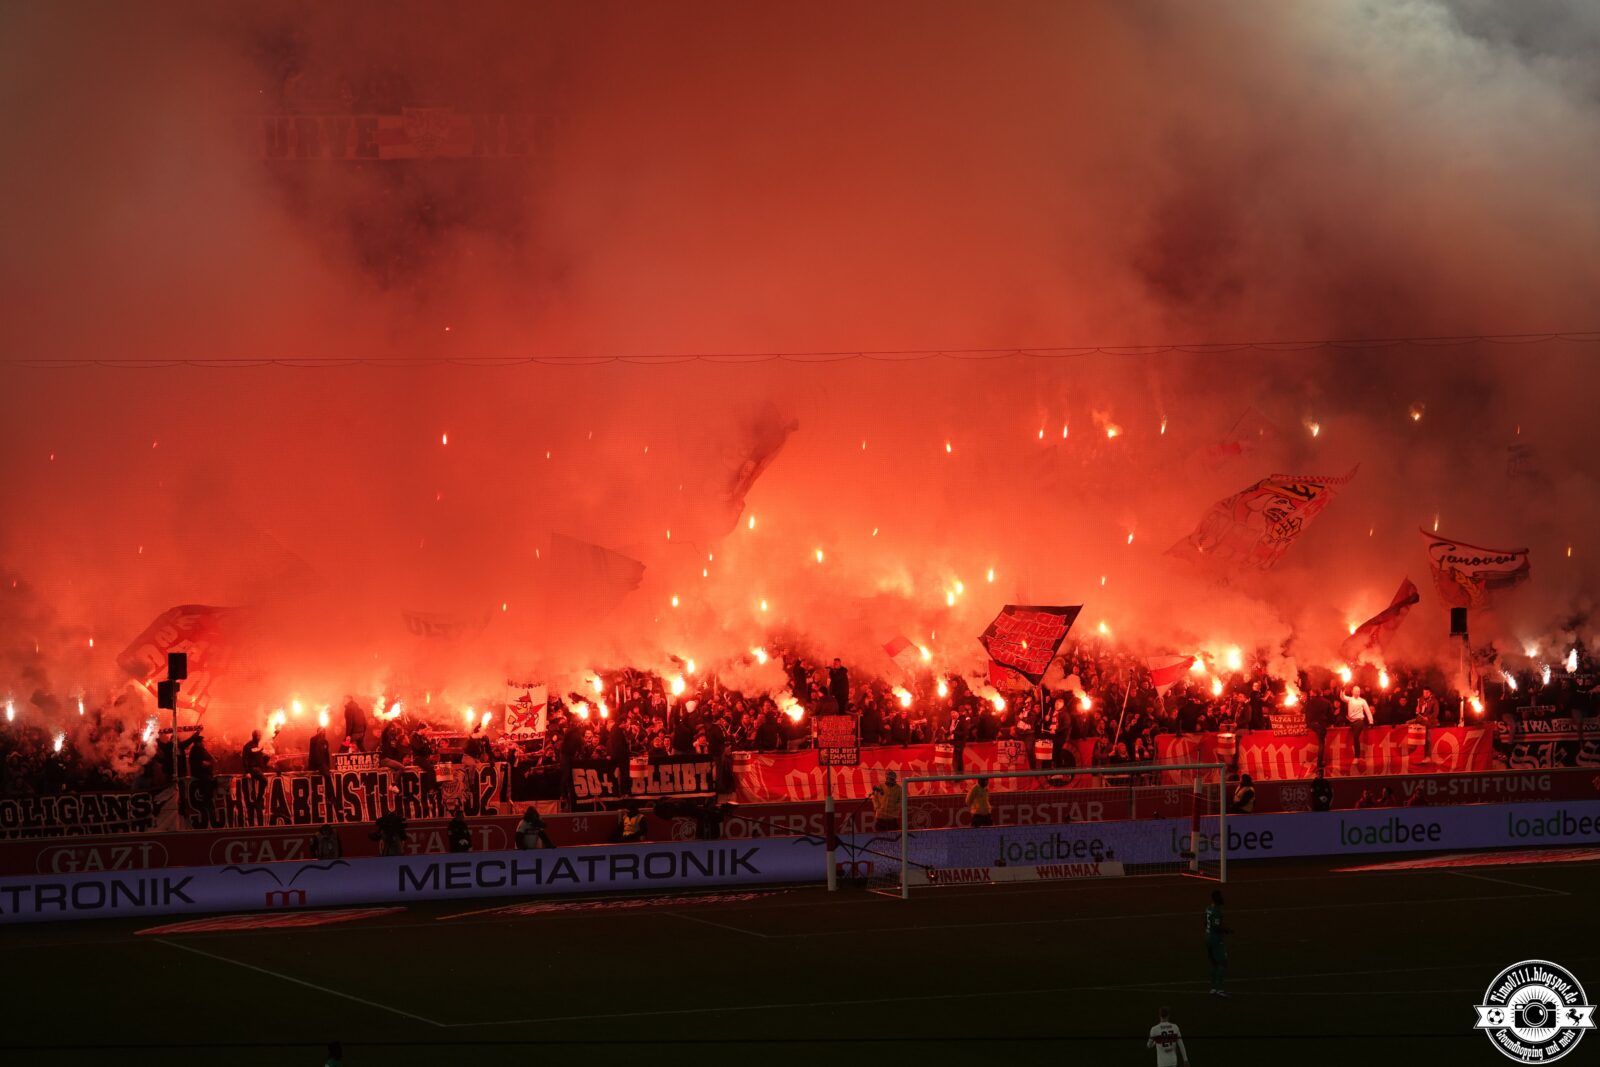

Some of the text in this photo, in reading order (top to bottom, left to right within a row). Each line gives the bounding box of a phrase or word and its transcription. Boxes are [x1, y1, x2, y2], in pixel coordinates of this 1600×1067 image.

[1497, 718, 1578, 733] SHWABEN
[336, 753, 380, 766] ULTRAS
[1430, 728, 1486, 772] 97
[1163, 789, 1180, 805] 35
[571, 817, 589, 833] 34
[718, 811, 877, 841] JOKERSAR
[947, 801, 1104, 827] JOERSTAR
[1340, 817, 1442, 846] loadbee
[1000, 832, 1104, 862] loadbee
[399, 848, 761, 892] MECHATRONIK
[1036, 863, 1102, 879] WINAMAX
[0, 876, 195, 914] TRONIK
